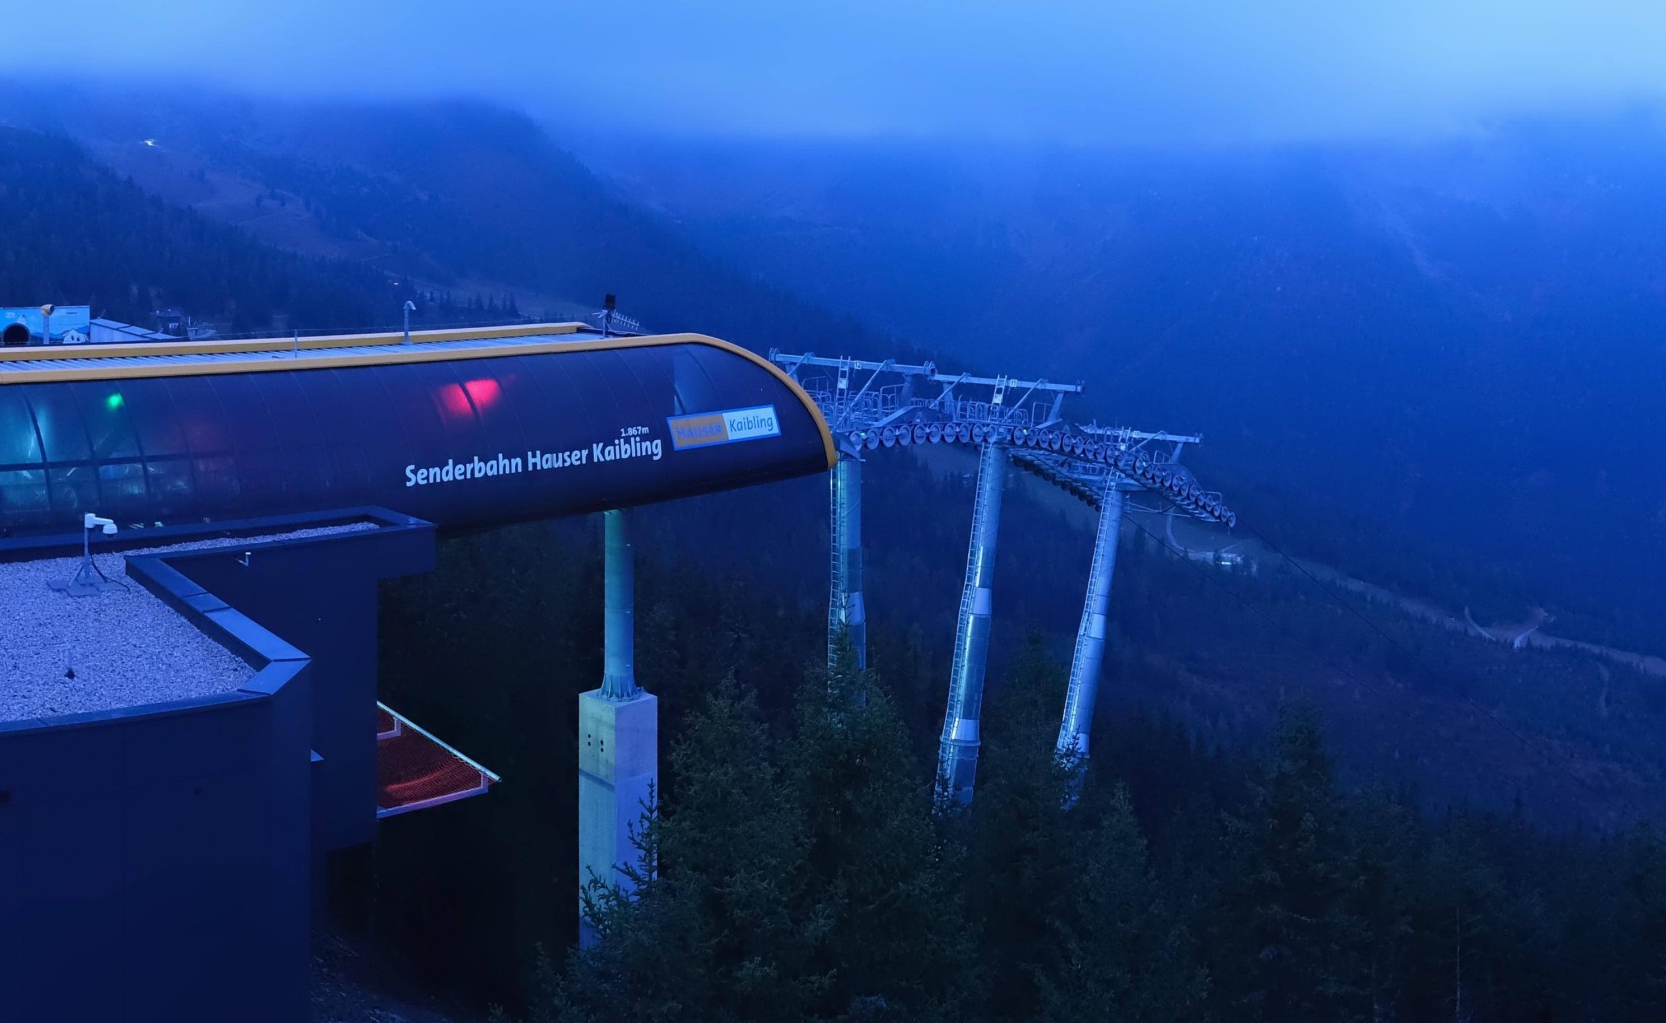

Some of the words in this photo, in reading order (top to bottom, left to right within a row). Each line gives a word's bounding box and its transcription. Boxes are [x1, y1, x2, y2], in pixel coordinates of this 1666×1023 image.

[620, 426, 649, 437] 1.867m
[729, 415, 773, 432] Kaibling
[405, 452, 522, 487] Senderbahn
[528, 447, 589, 472] Hauser
[592, 437, 662, 463] Kaibling
